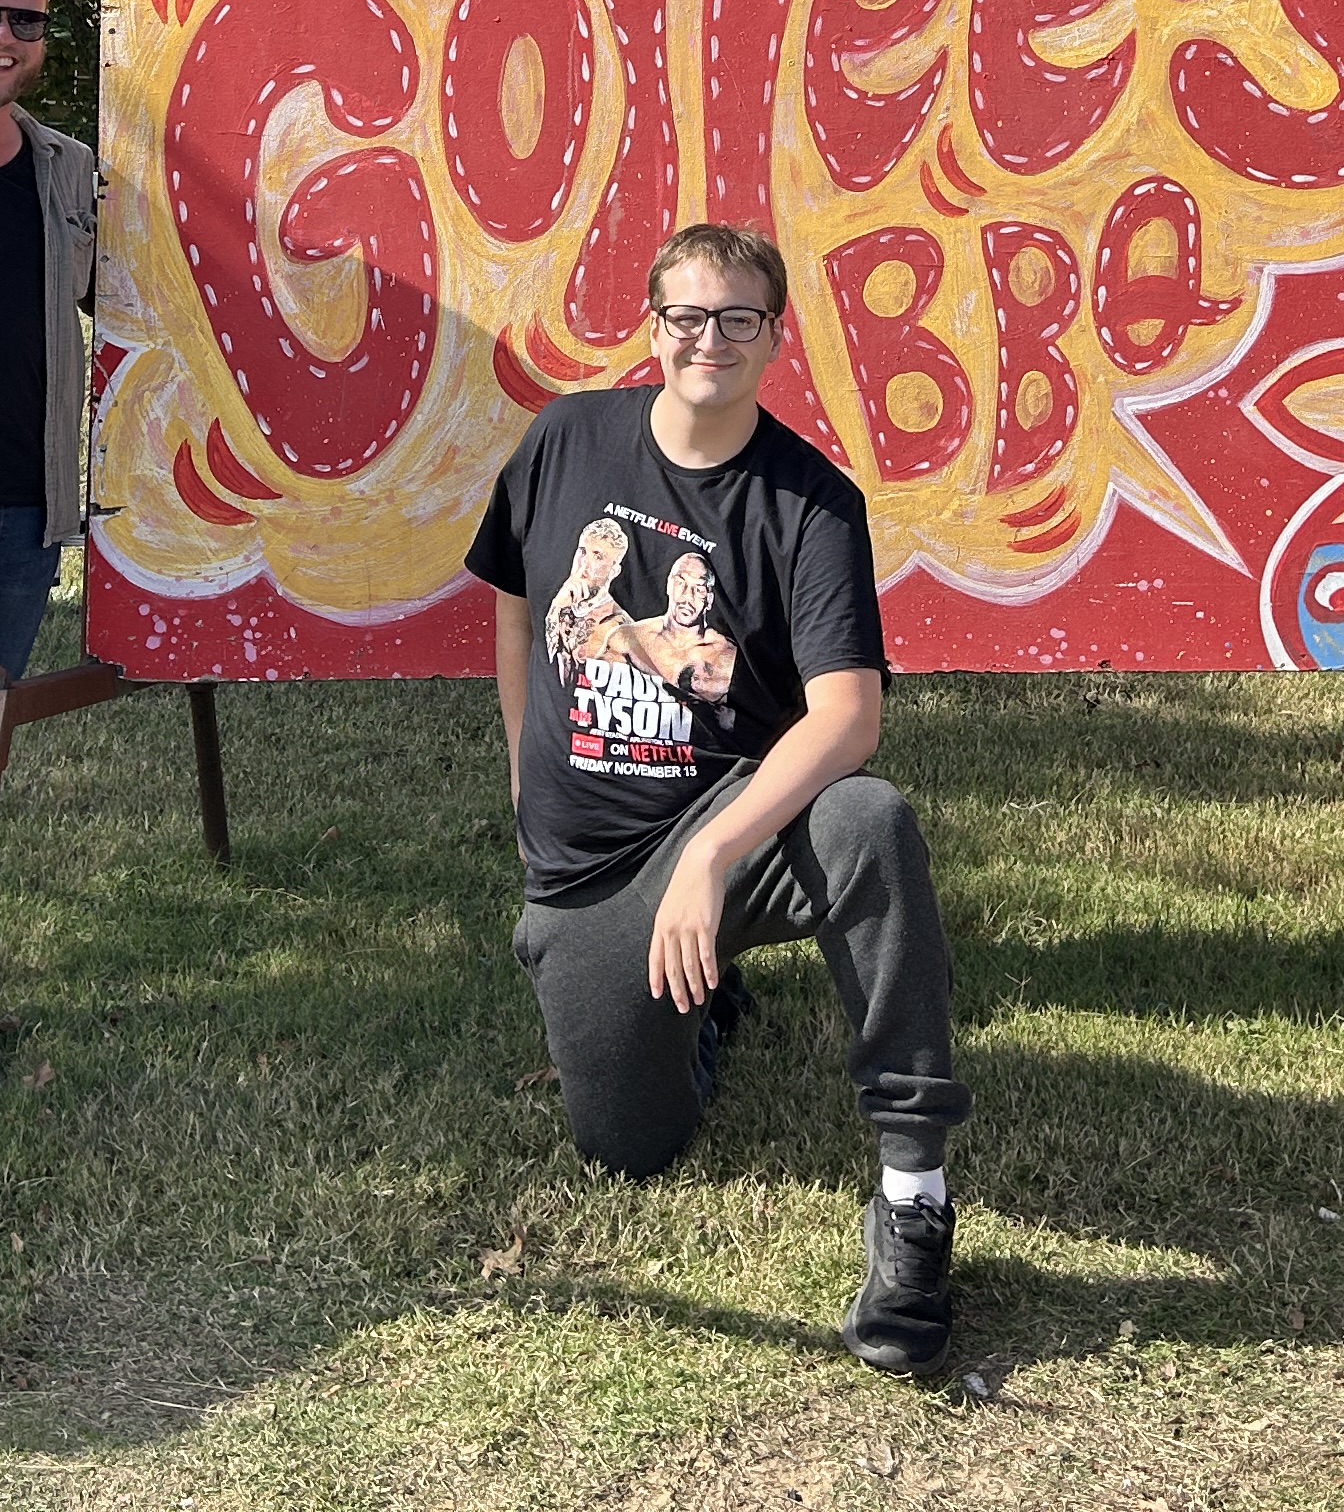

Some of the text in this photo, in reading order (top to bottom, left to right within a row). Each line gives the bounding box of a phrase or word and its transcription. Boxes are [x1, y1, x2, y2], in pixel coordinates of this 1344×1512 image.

[822, 176, 1244, 494] BBQ
[603, 502, 717, 554] A NETFLIX LIVE EVENT
[573, 687, 694, 743] TYSON
[569, 754, 698, 779] FRIDAY NOVEMBER 15
[580, 740, 696, 764] LIVE ON NETFLIX
